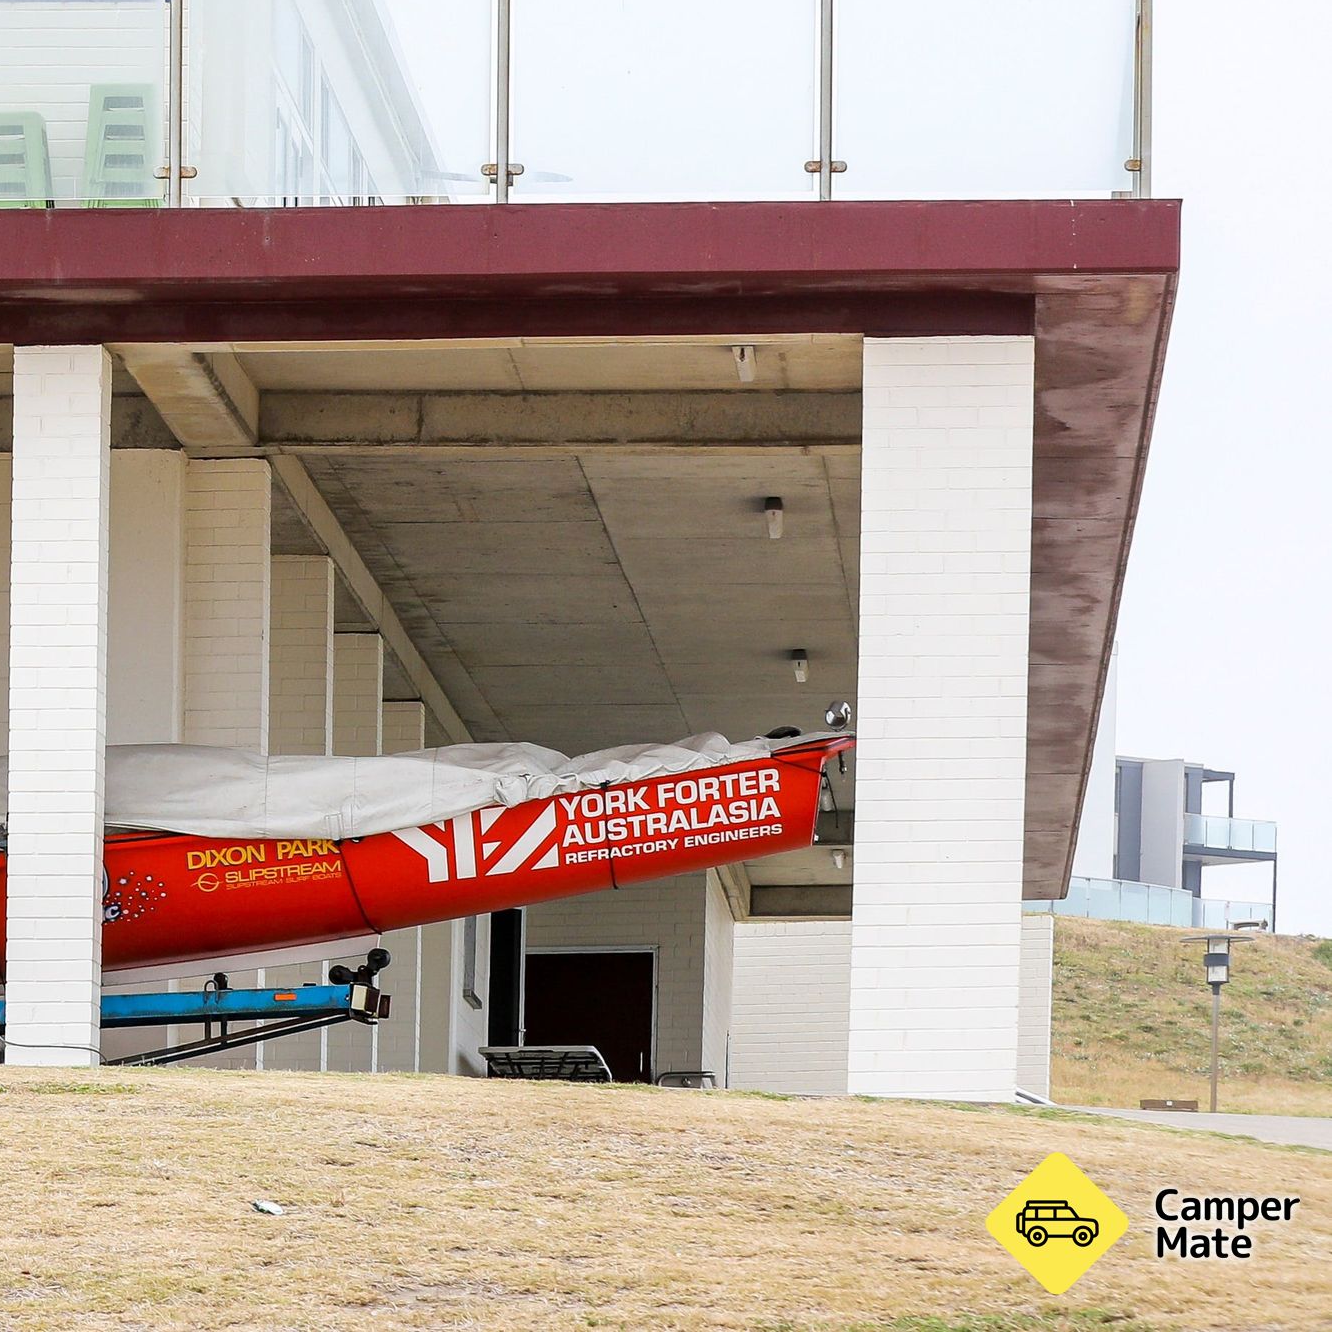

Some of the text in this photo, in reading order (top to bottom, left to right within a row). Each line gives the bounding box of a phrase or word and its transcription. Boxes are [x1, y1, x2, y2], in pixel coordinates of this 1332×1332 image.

[559, 768, 781, 821] YORK FORTER
[562, 796, 781, 848] AUSTRALASIA
[187, 839, 340, 870] DIXON PARK
[565, 823, 783, 865] REFRACTORY ENGINEERS
[225, 860, 342, 884] SLIPSTREAM
[226, 871, 342, 890] SLIPSTREAM SURF BOATS
